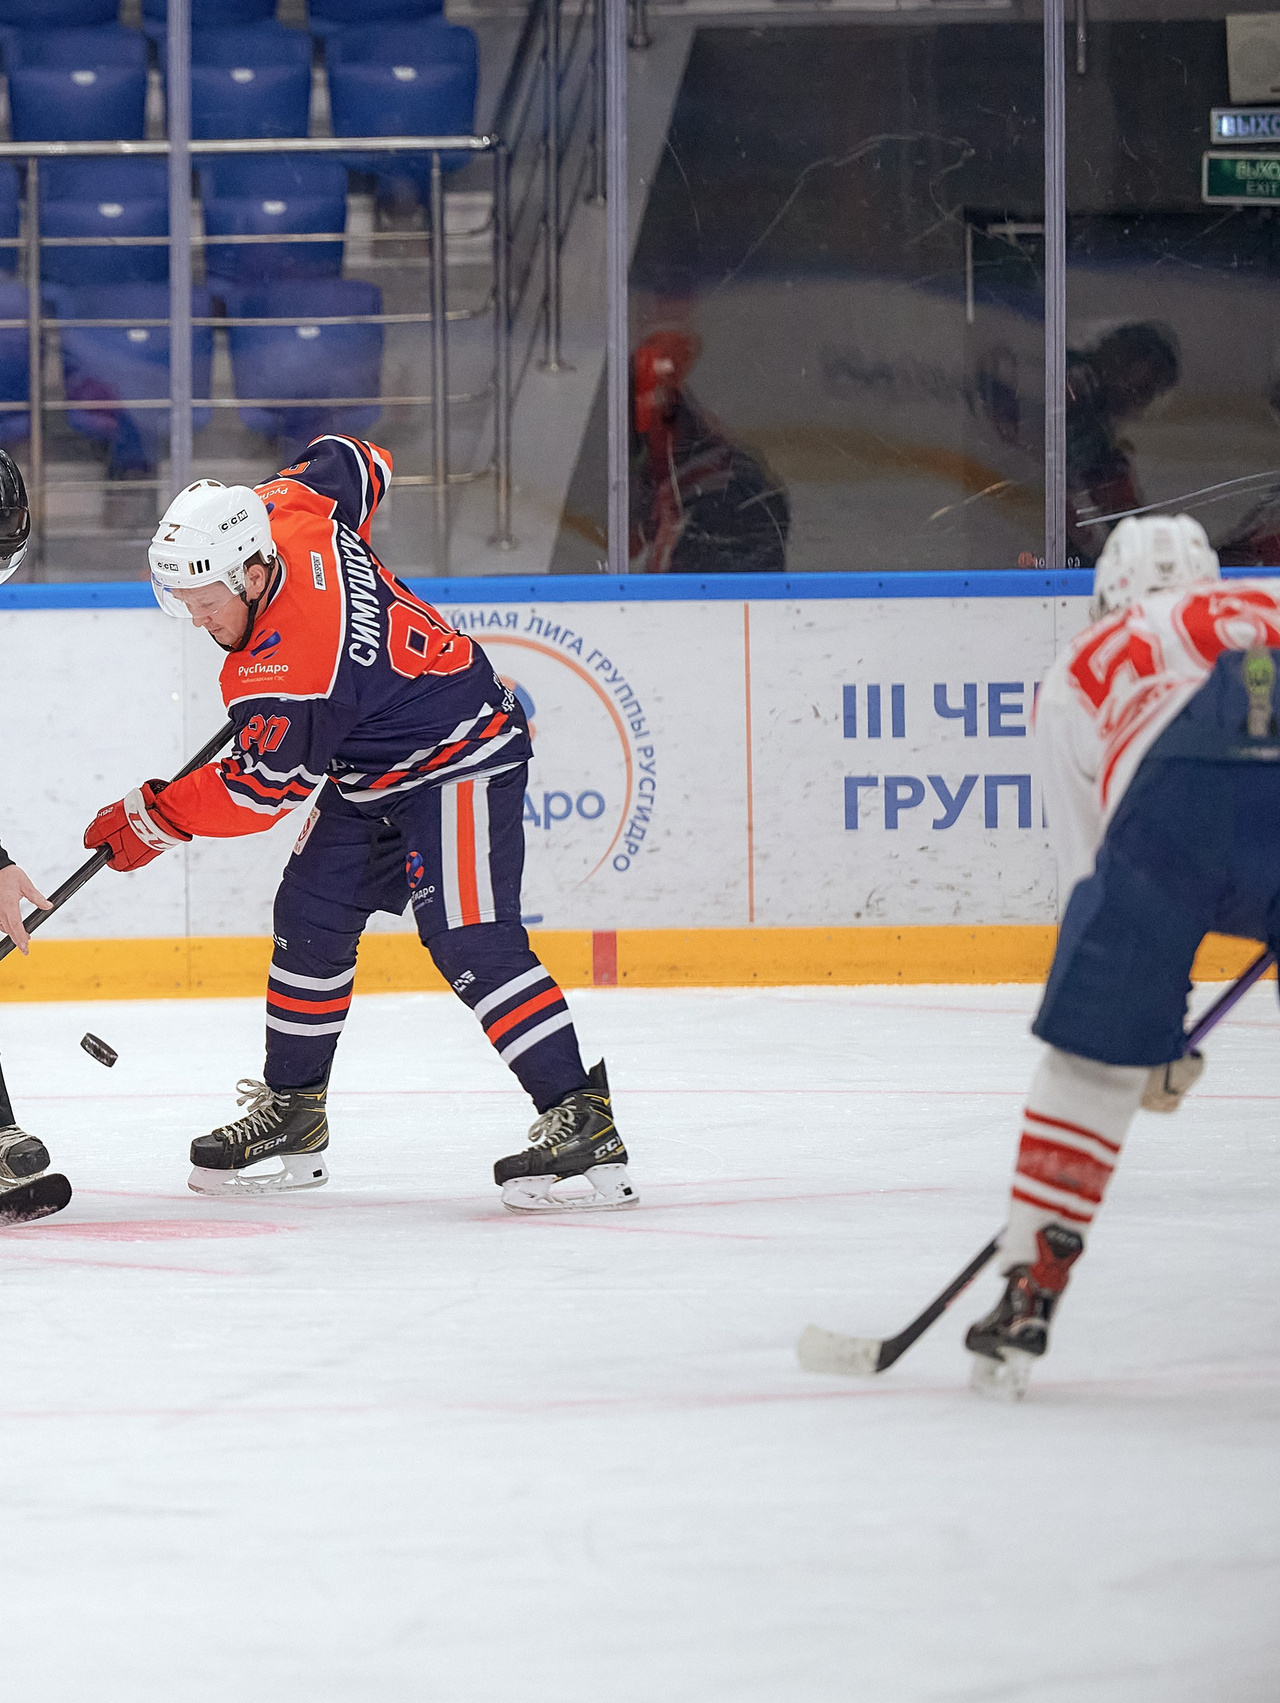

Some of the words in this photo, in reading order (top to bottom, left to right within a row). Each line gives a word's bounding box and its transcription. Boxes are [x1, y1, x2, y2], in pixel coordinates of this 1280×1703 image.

[220, 509, 249, 532] CCM
[157, 561, 179, 572] CCM
[450, 608, 518, 630] ЙНАЯ
[524, 614, 584, 656] ЛИГА
[238, 663, 289, 677] РусГидро
[585, 649, 650, 740] ГРУППЫ
[843, 683, 906, 738] III
[612, 743, 656, 872] РУСГИДРО
[844, 774, 1048, 831] ГРУП
[251, 1134, 288, 1156] CCM
